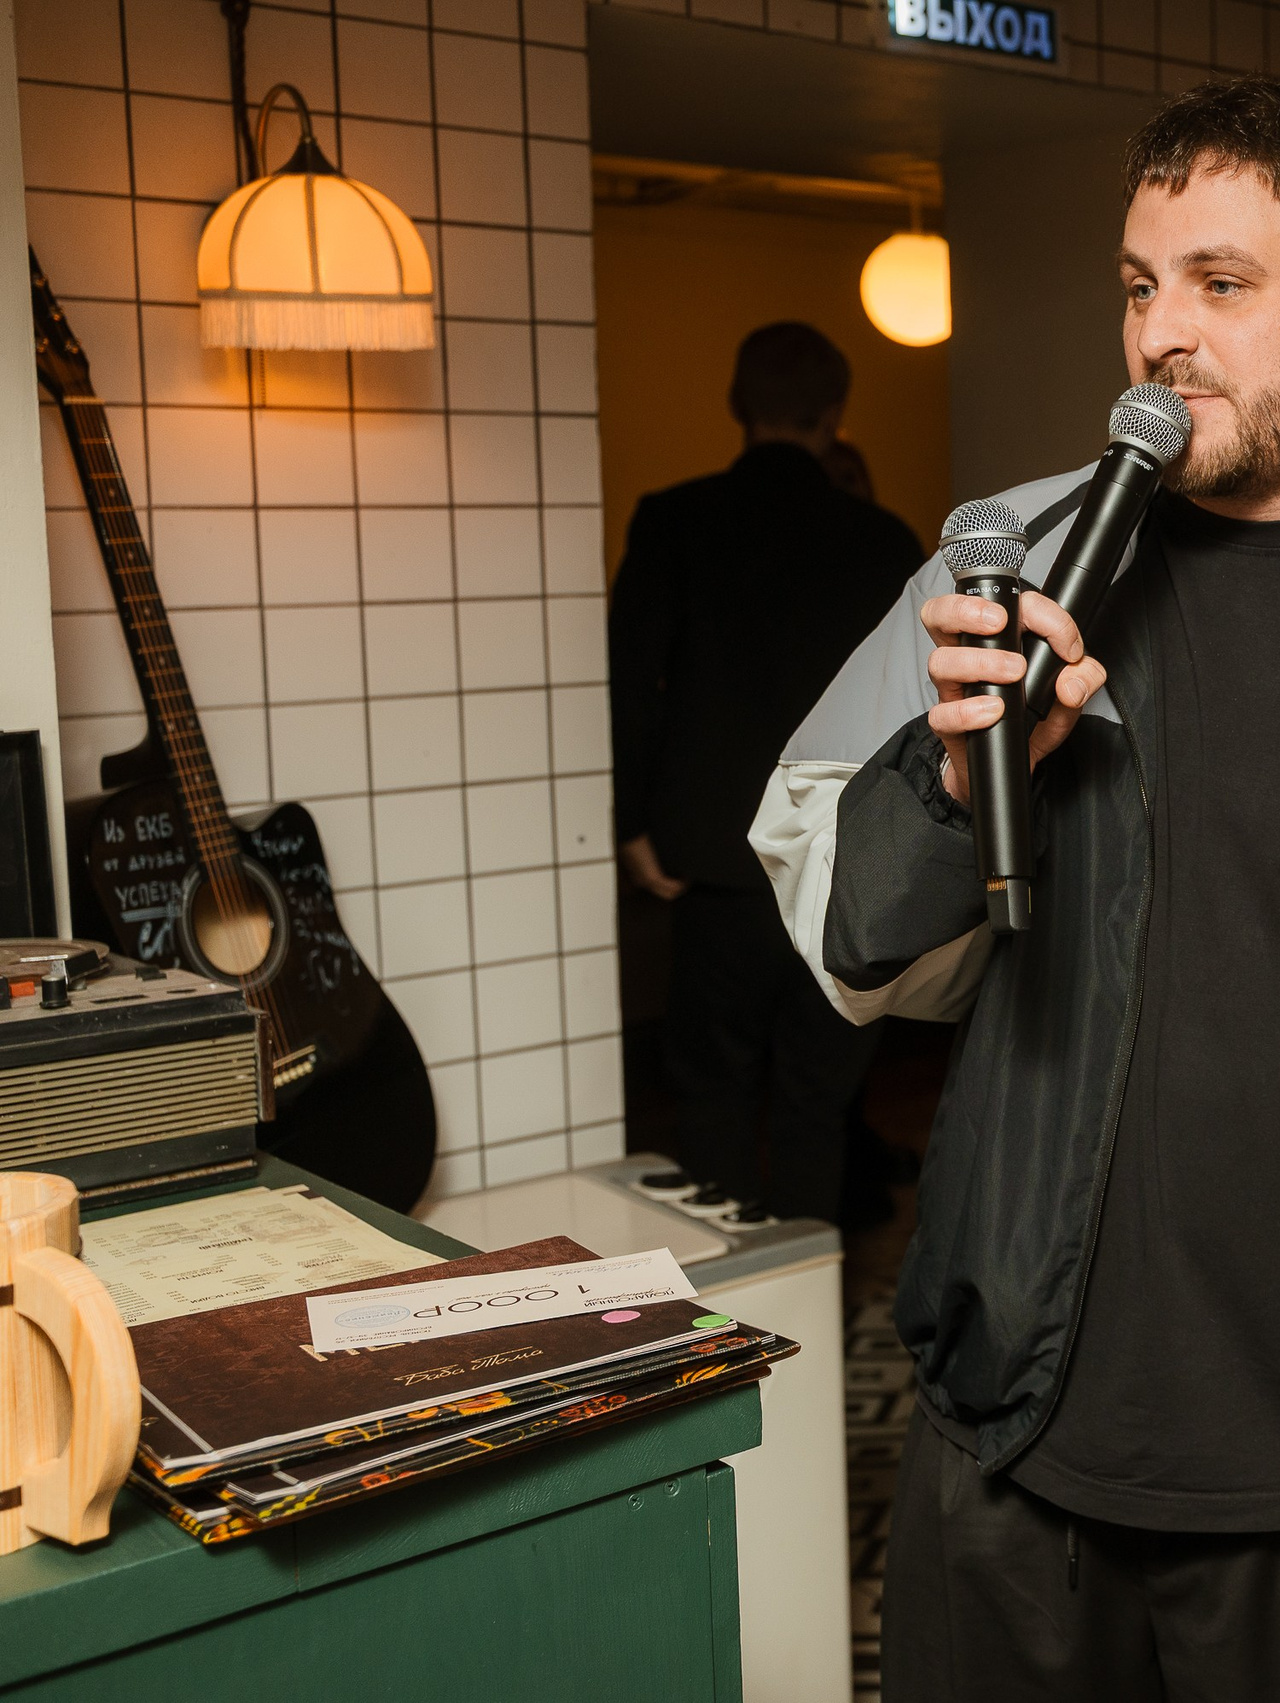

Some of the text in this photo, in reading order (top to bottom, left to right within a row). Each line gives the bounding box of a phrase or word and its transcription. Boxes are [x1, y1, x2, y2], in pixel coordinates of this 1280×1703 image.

[895, 0, 1053, 60] ВЫХОД
[103, 812, 173, 843] Из ЕКБ
[577, 1284, 591, 1295] 1
[584, 1290, 675, 1307] ПОДАРОЧНЫЙ
